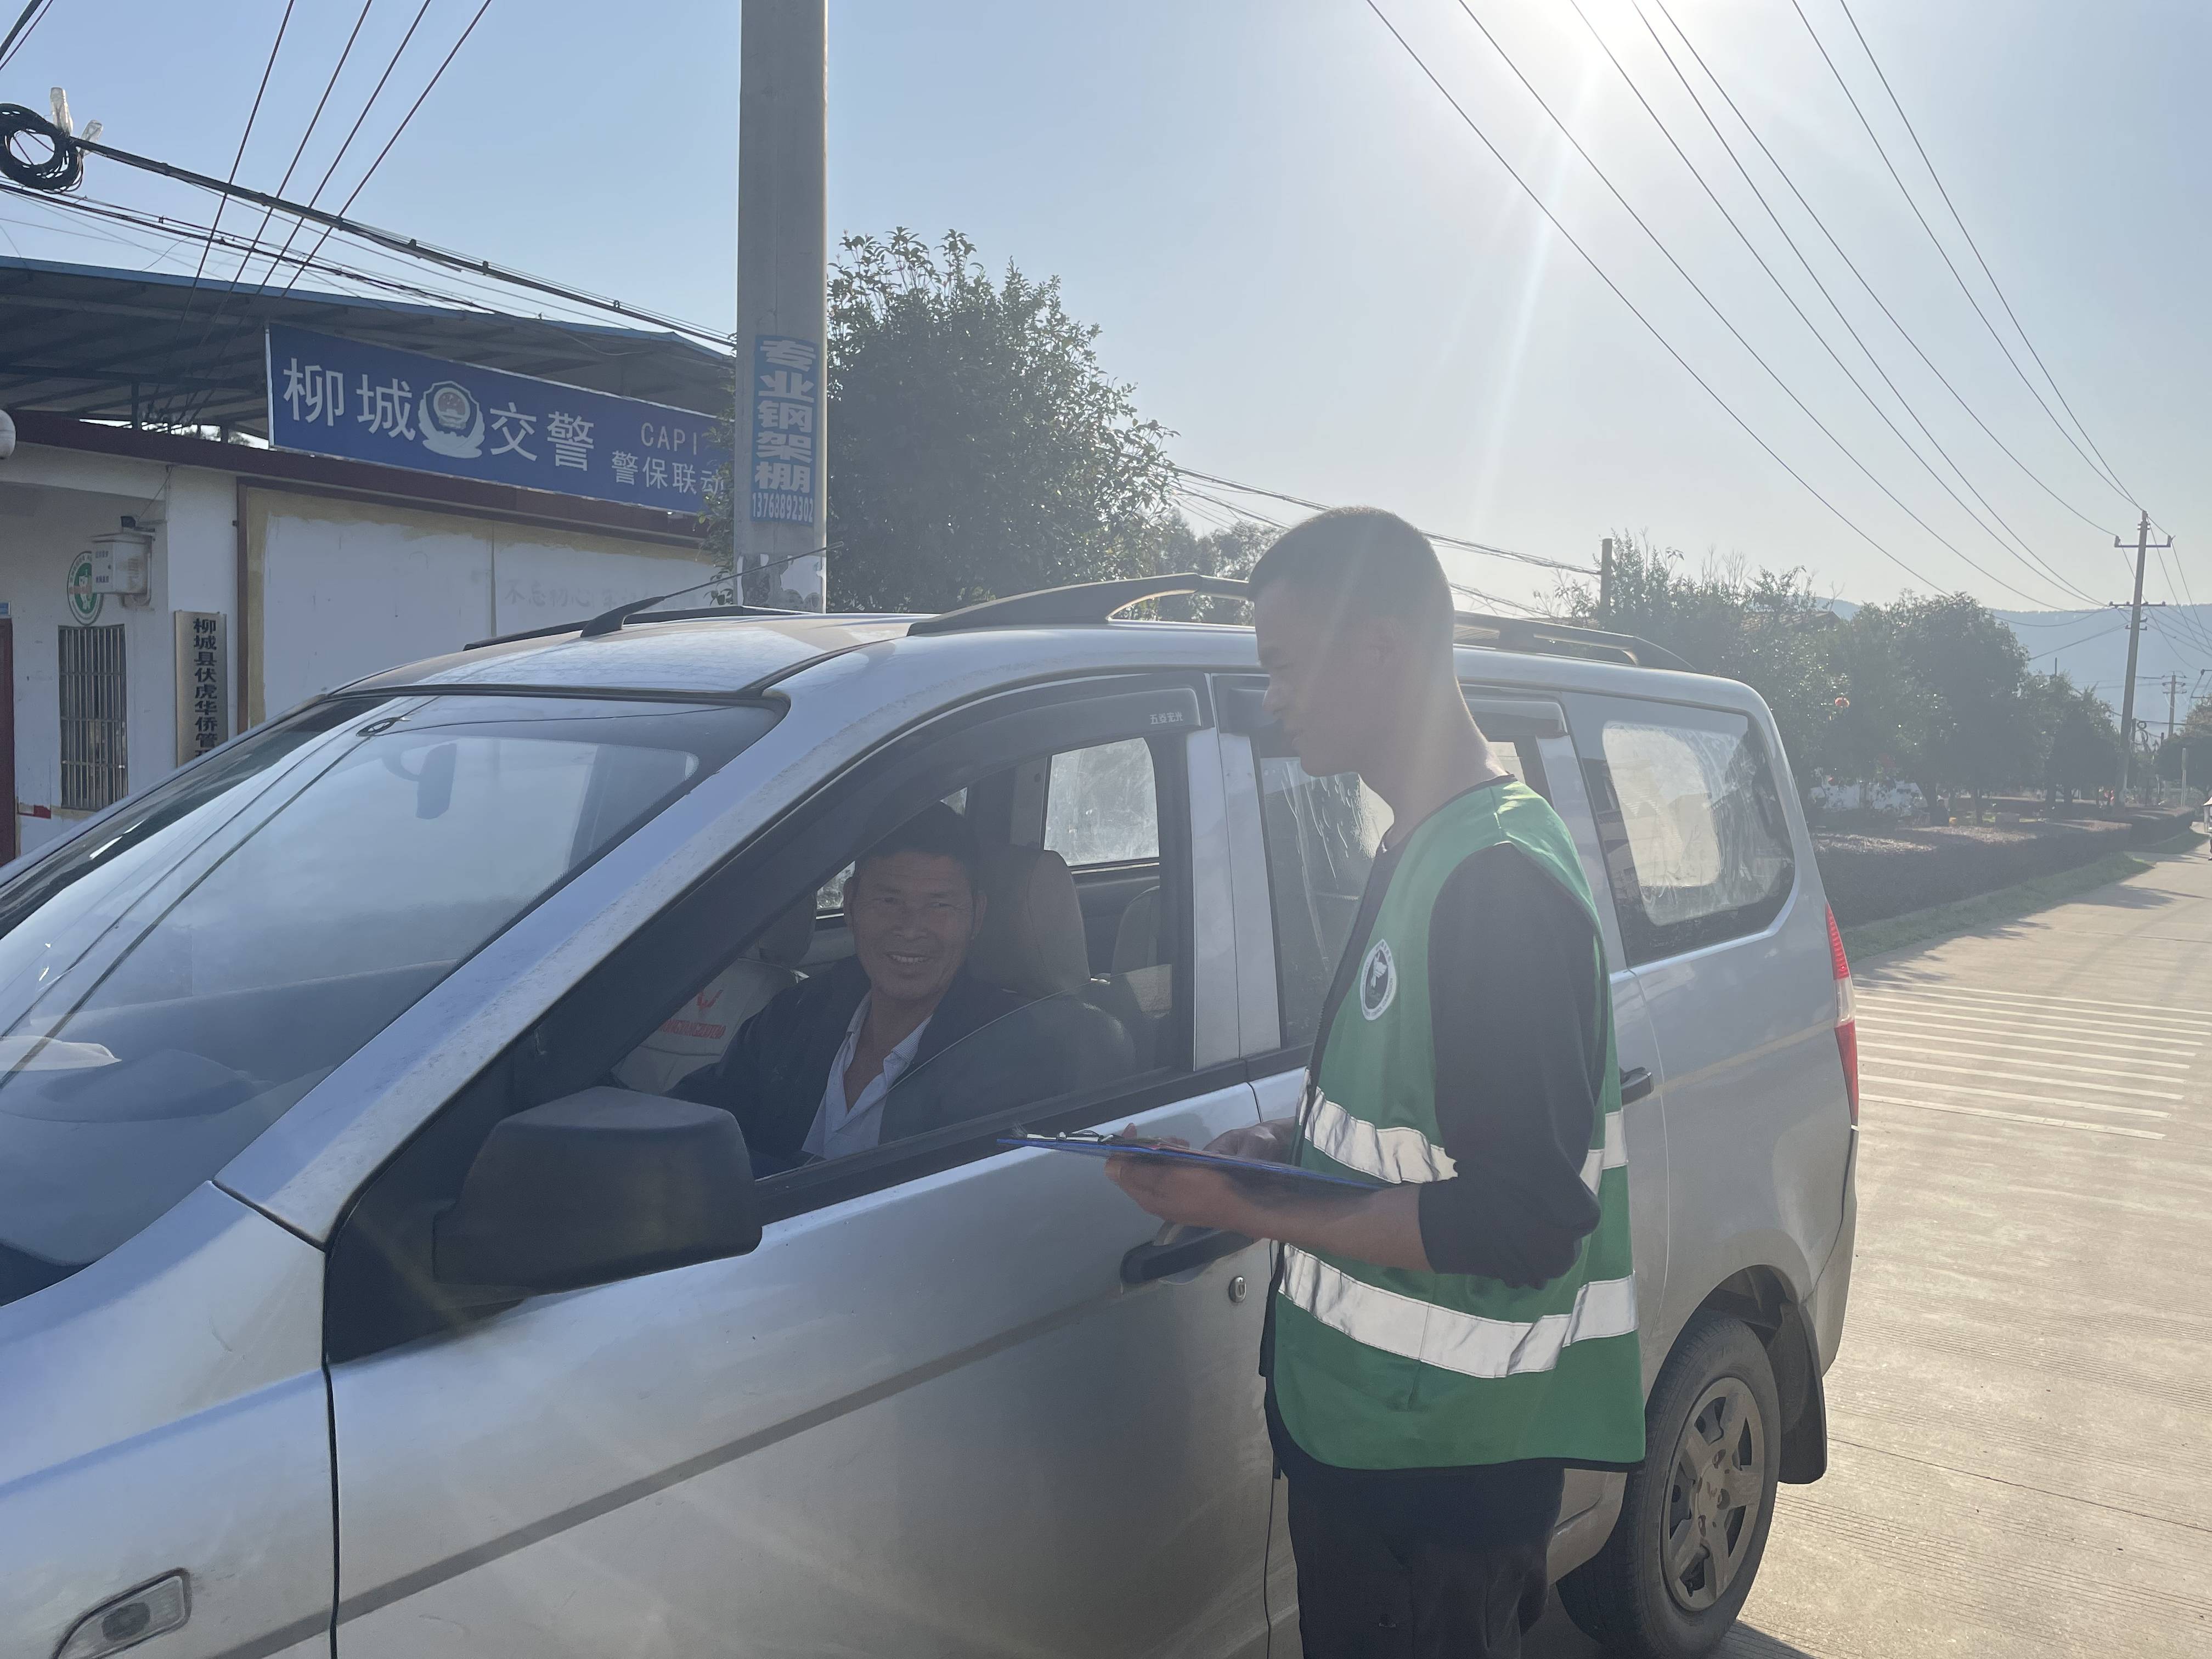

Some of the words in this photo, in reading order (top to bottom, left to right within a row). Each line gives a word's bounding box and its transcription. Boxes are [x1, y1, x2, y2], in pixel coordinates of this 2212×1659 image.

[282, 357, 415, 441] 柳城
[489, 401, 595, 471] 交警
[754, 339, 816, 494] 专业钢架棚
[611, 450, 724, 500] 警保联动
[752, 492, 814, 523] 13768892302
